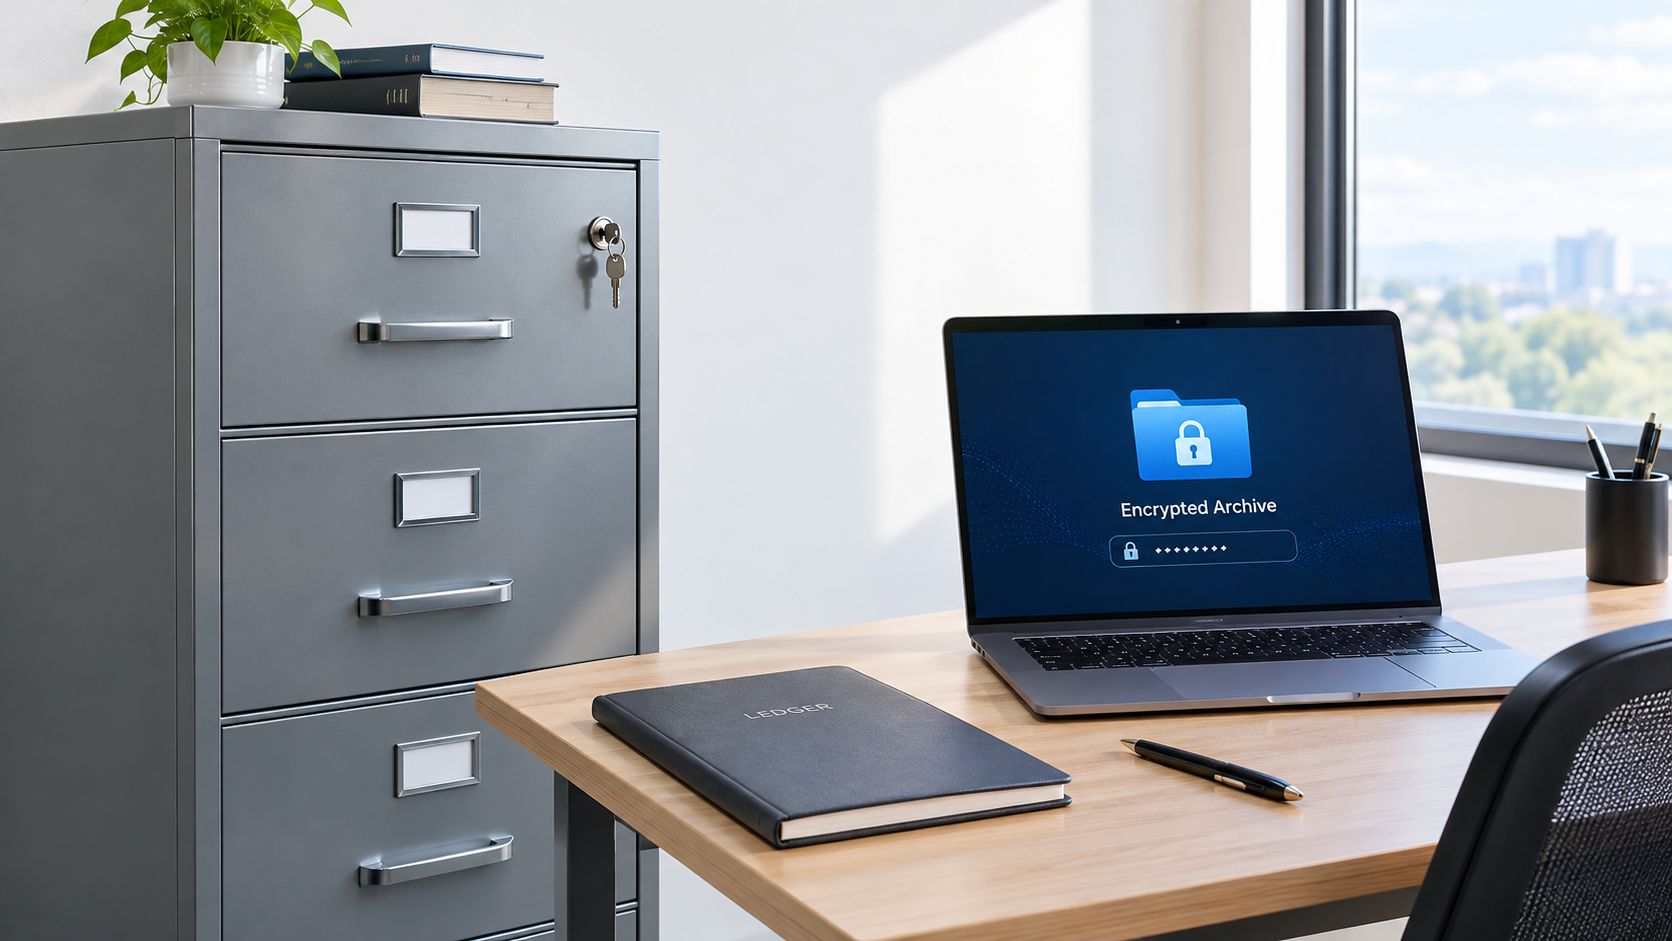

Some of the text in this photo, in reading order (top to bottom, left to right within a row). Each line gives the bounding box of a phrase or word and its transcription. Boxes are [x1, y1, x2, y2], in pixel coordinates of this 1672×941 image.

[1120, 498, 1277, 520] Encrypted Archive
[743, 703, 834, 720] LEDGER
